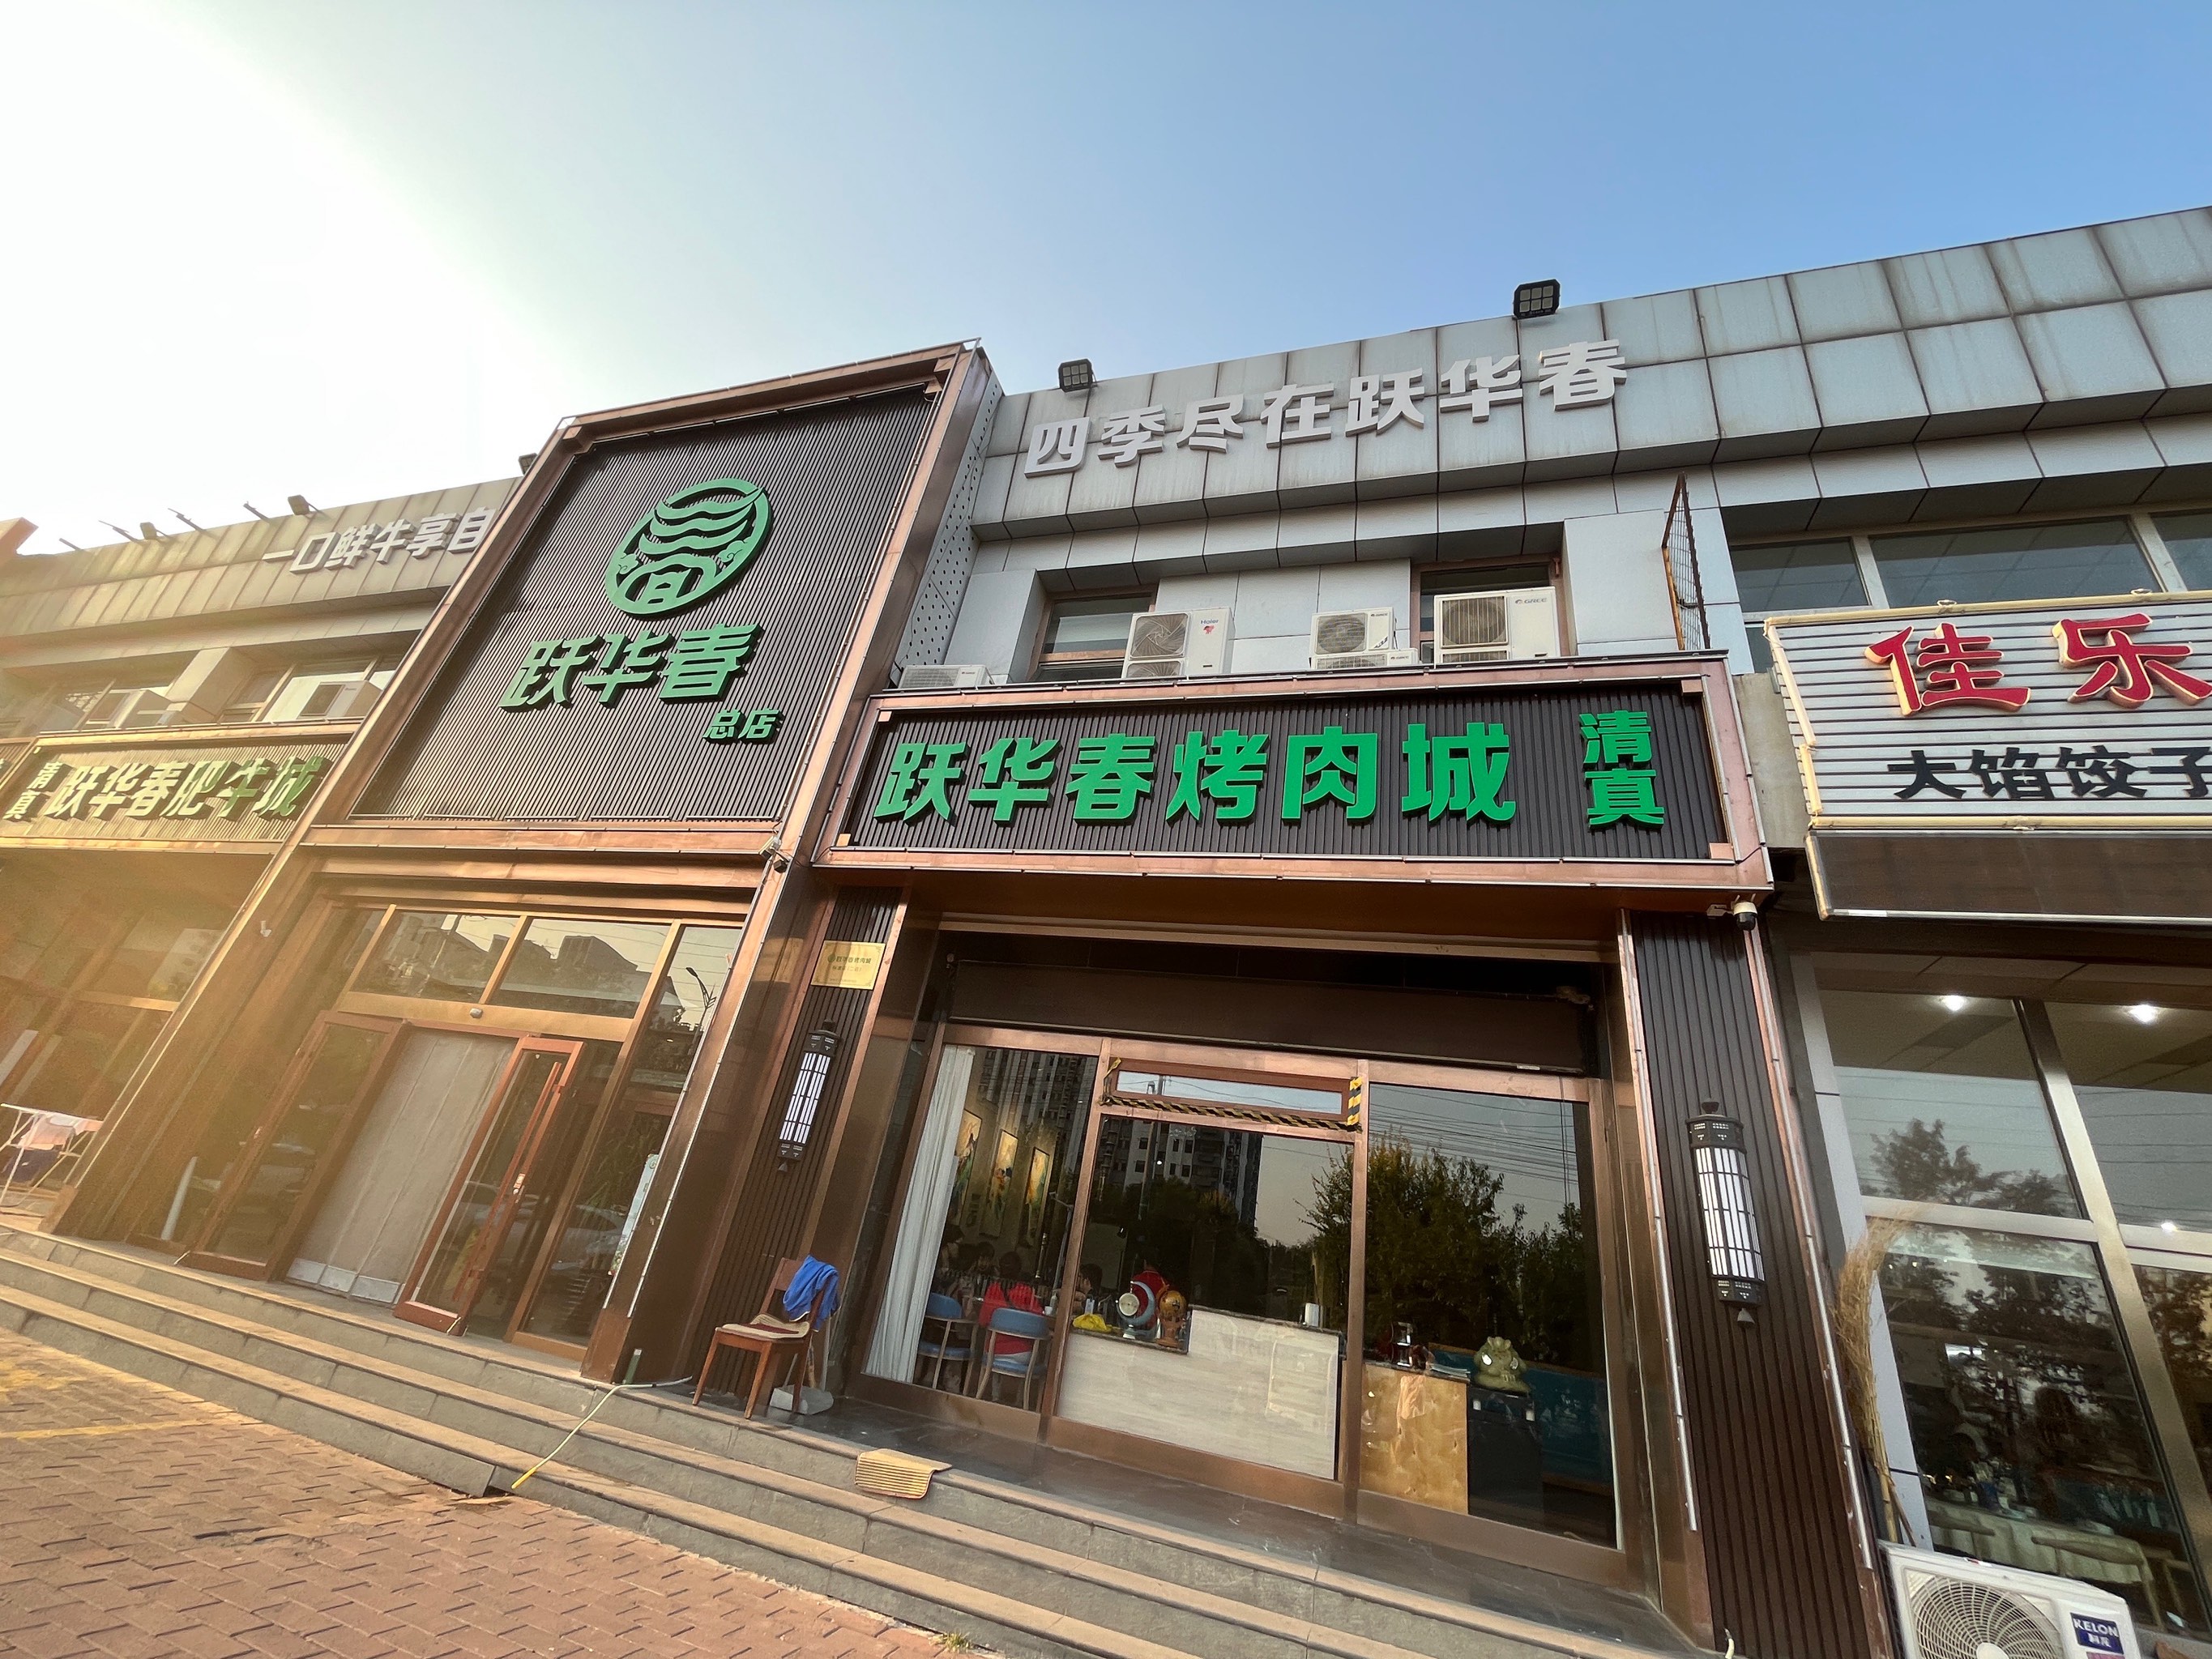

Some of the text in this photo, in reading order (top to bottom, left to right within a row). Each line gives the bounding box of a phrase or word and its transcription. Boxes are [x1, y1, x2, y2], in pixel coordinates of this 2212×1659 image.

[1024, 339, 1626, 477] 四季尽在跃华春
[498, 623, 762, 707] 跃华春
[1864, 612, 2212, 716] 佳乐
[702, 706, 780, 740] 总店
[2, 761, 64, 820] 清真
[44, 756, 323, 818] 跃华春肥牛城
[873, 722, 1516, 824] 跃华春烤肉城
[1578, 710, 1665, 827] 清真
[1887, 745, 2212, 800] 大馅饺子
[2073, 1618, 2120, 1637] KELON
